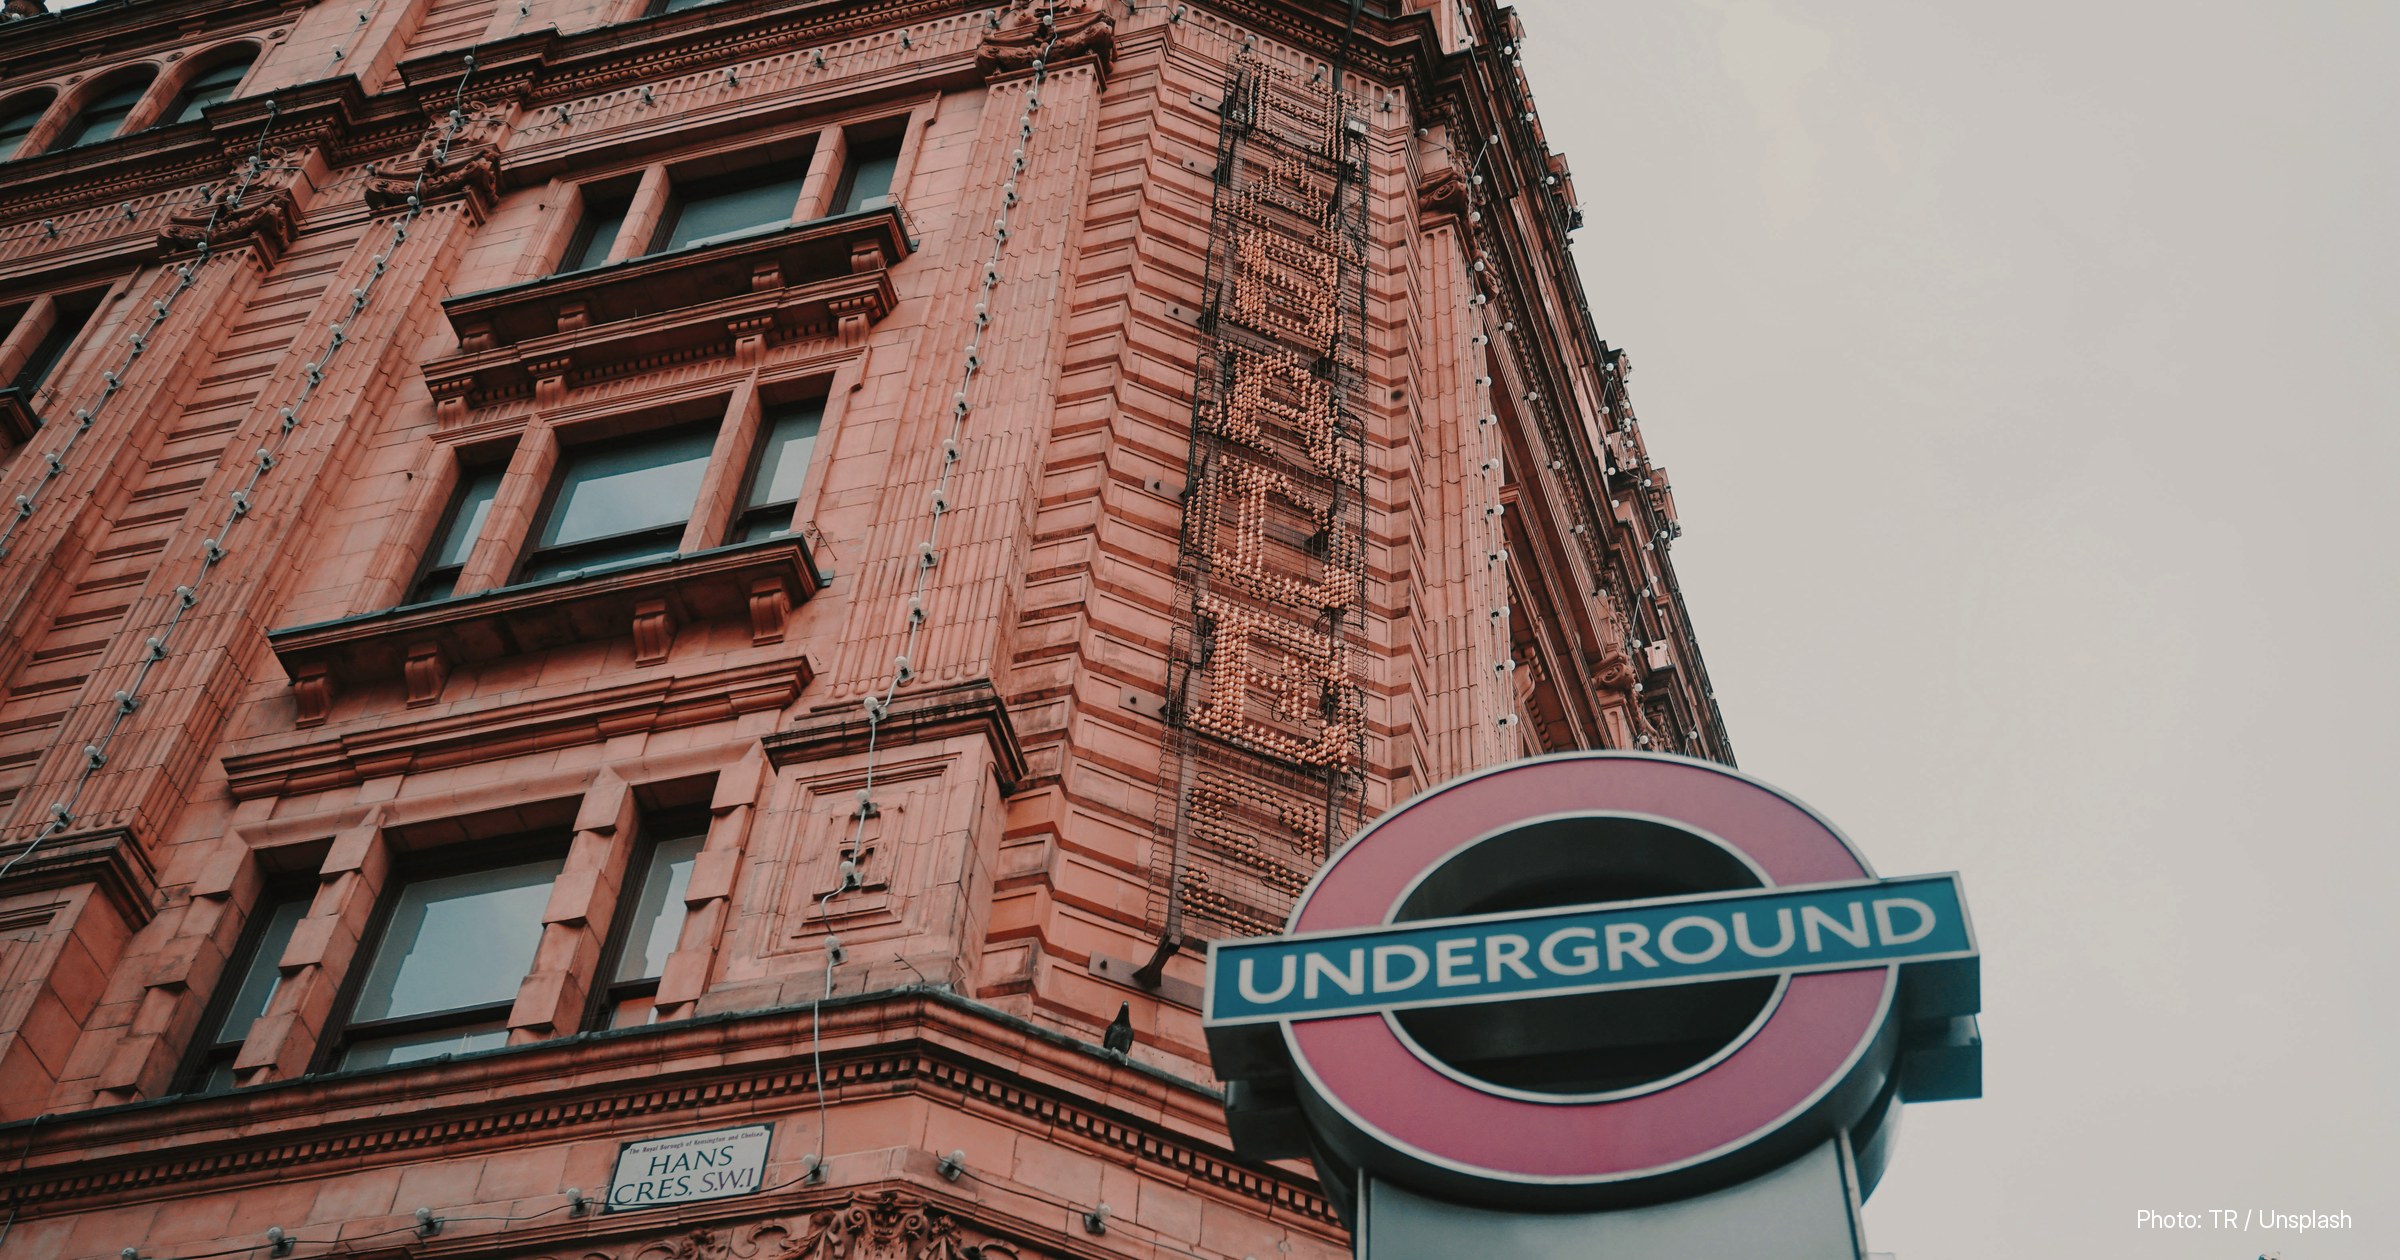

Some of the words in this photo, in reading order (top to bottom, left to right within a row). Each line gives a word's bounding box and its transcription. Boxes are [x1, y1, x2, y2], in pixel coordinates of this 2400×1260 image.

[1238, 898, 1938, 1004] UNDERGROUND
[642, 1145, 659, 1154] Royal
[659, 1141, 684, 1151] Borough
[685, 1140, 693, 1148] of
[693, 1136, 726, 1147] Kensington
[647, 1145, 734, 1177] HANS
[614, 1175, 693, 1205] CRES.
[699, 1167, 754, 1193] S.W.1
